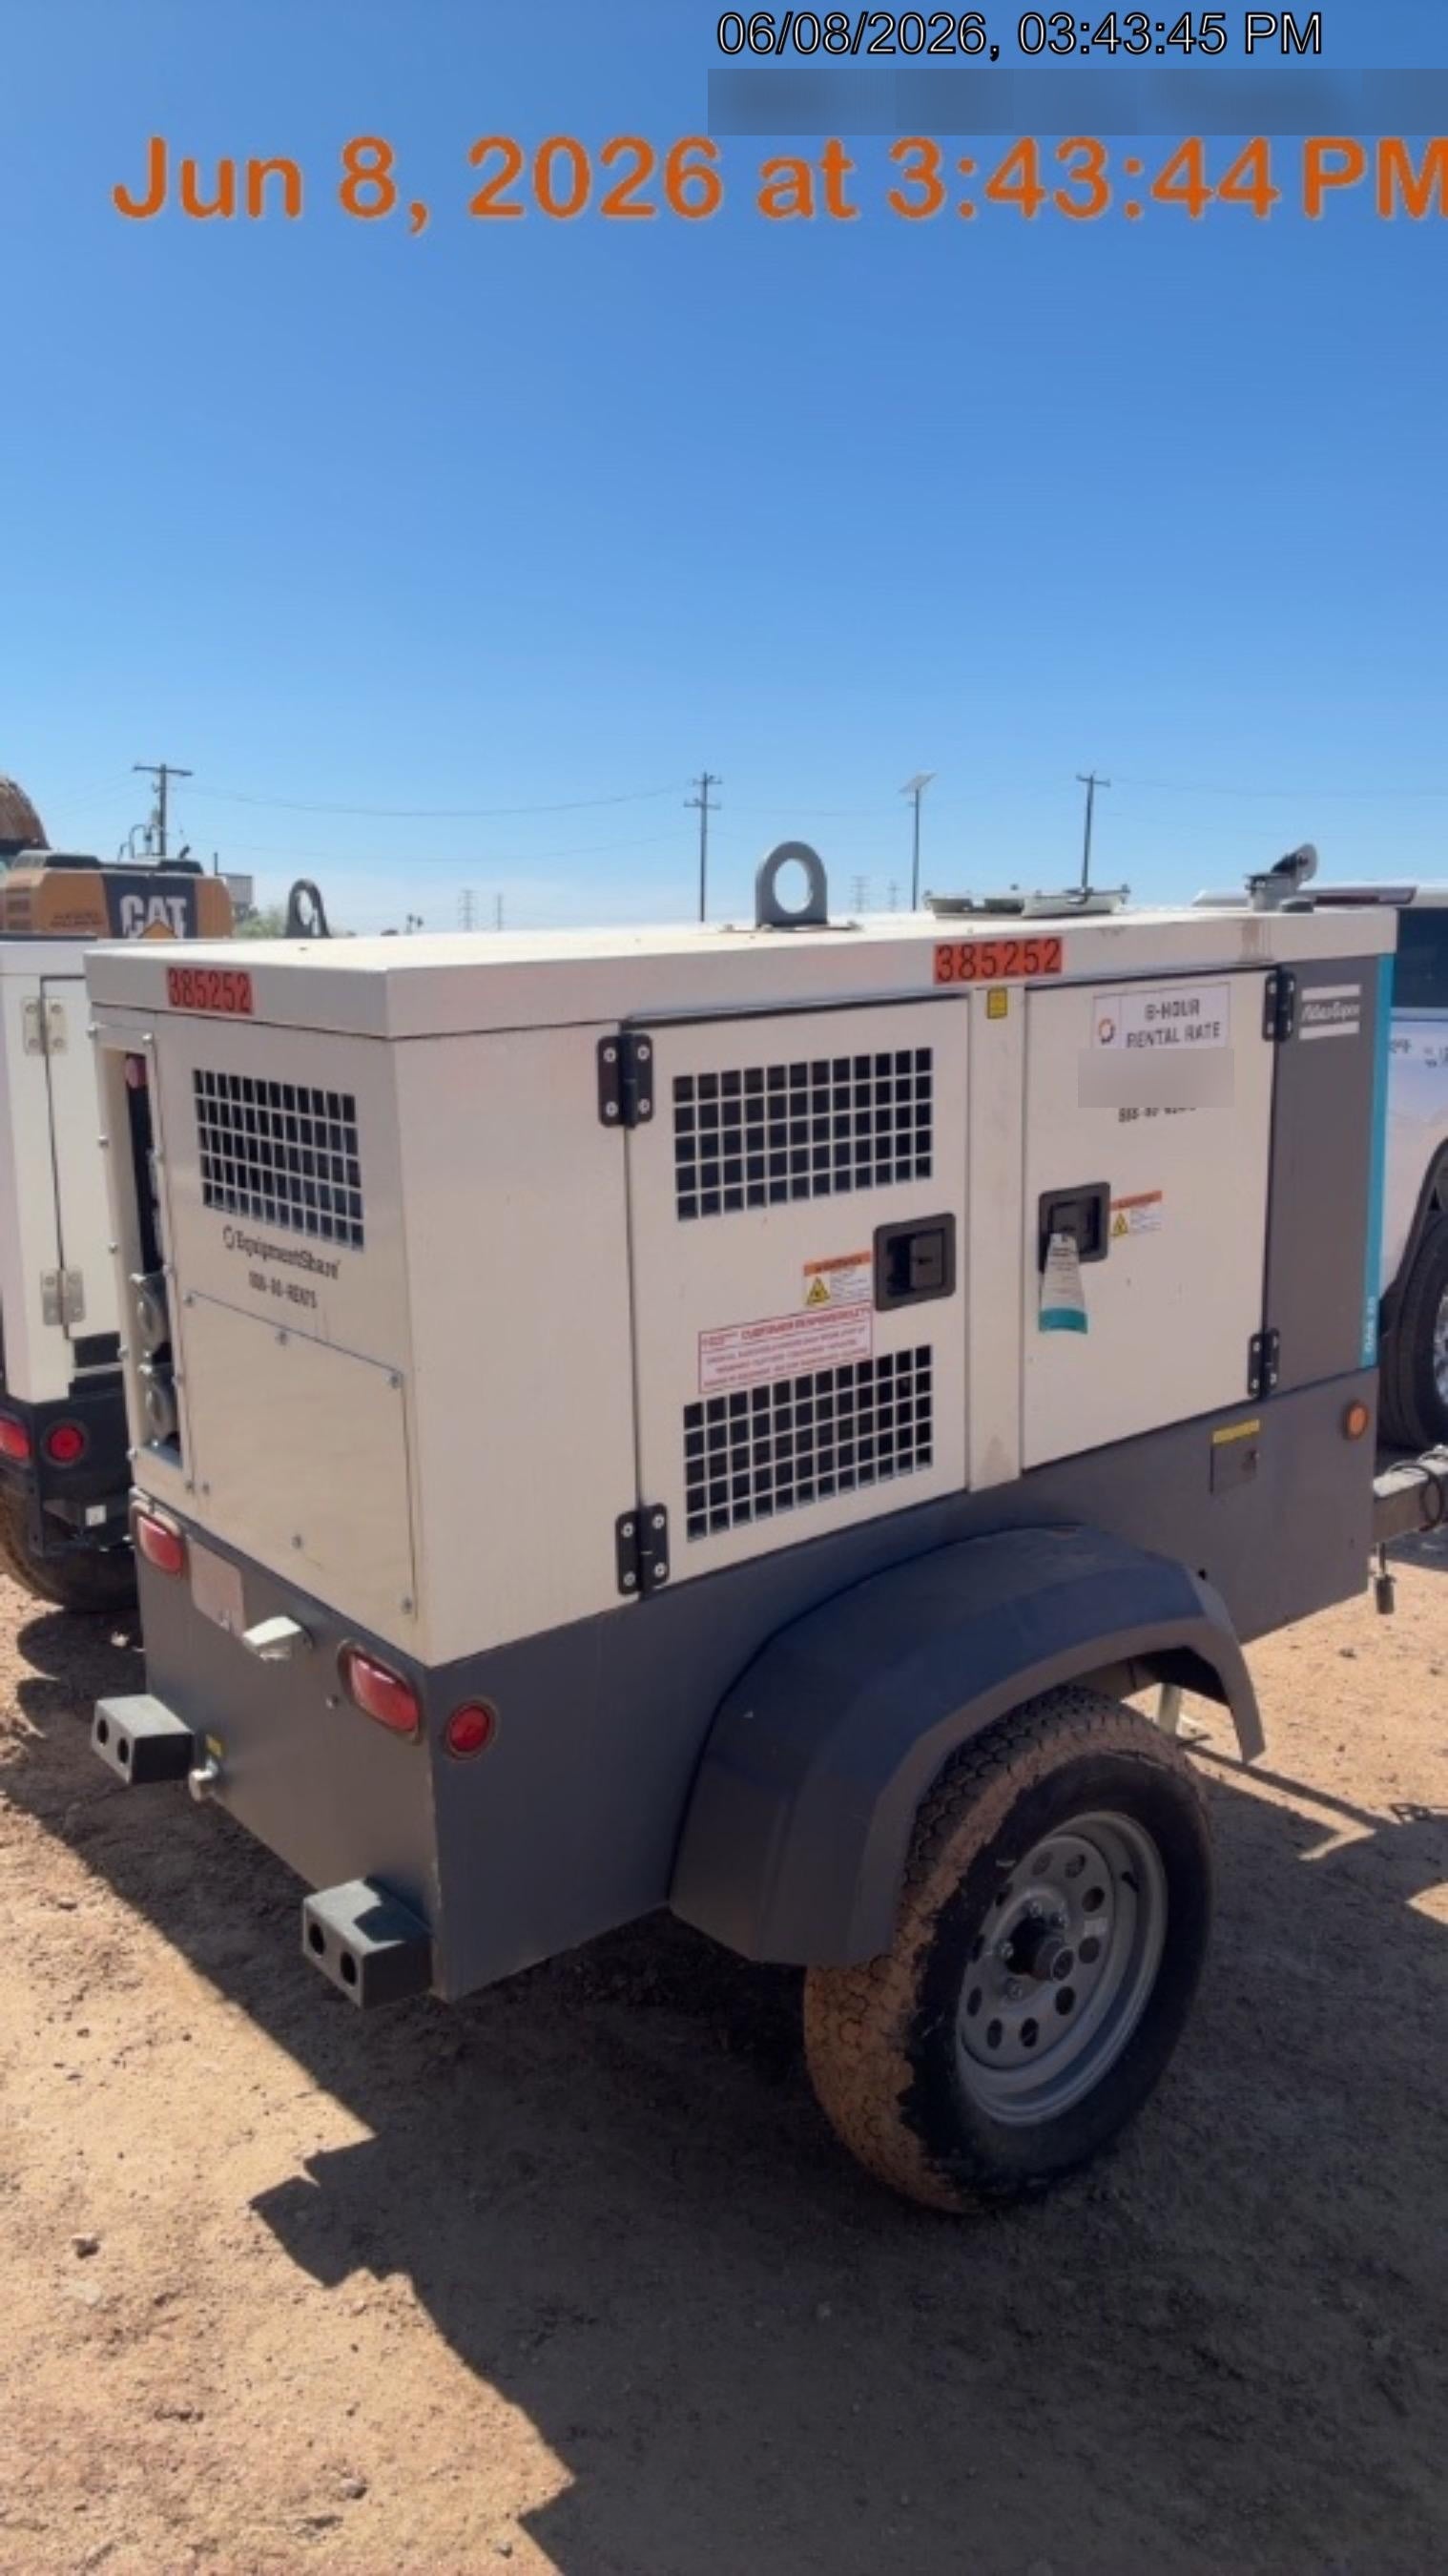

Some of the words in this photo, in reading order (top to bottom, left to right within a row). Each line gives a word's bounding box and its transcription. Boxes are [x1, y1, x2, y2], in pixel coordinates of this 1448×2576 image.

[120, 894, 187, 939] CAT
[937, 937, 1061, 983] 385252
[167, 966, 252, 1014] 385252
[1126, 1027, 1181, 1049] RENTAL
[1184, 1022, 1221, 1043] RATE
